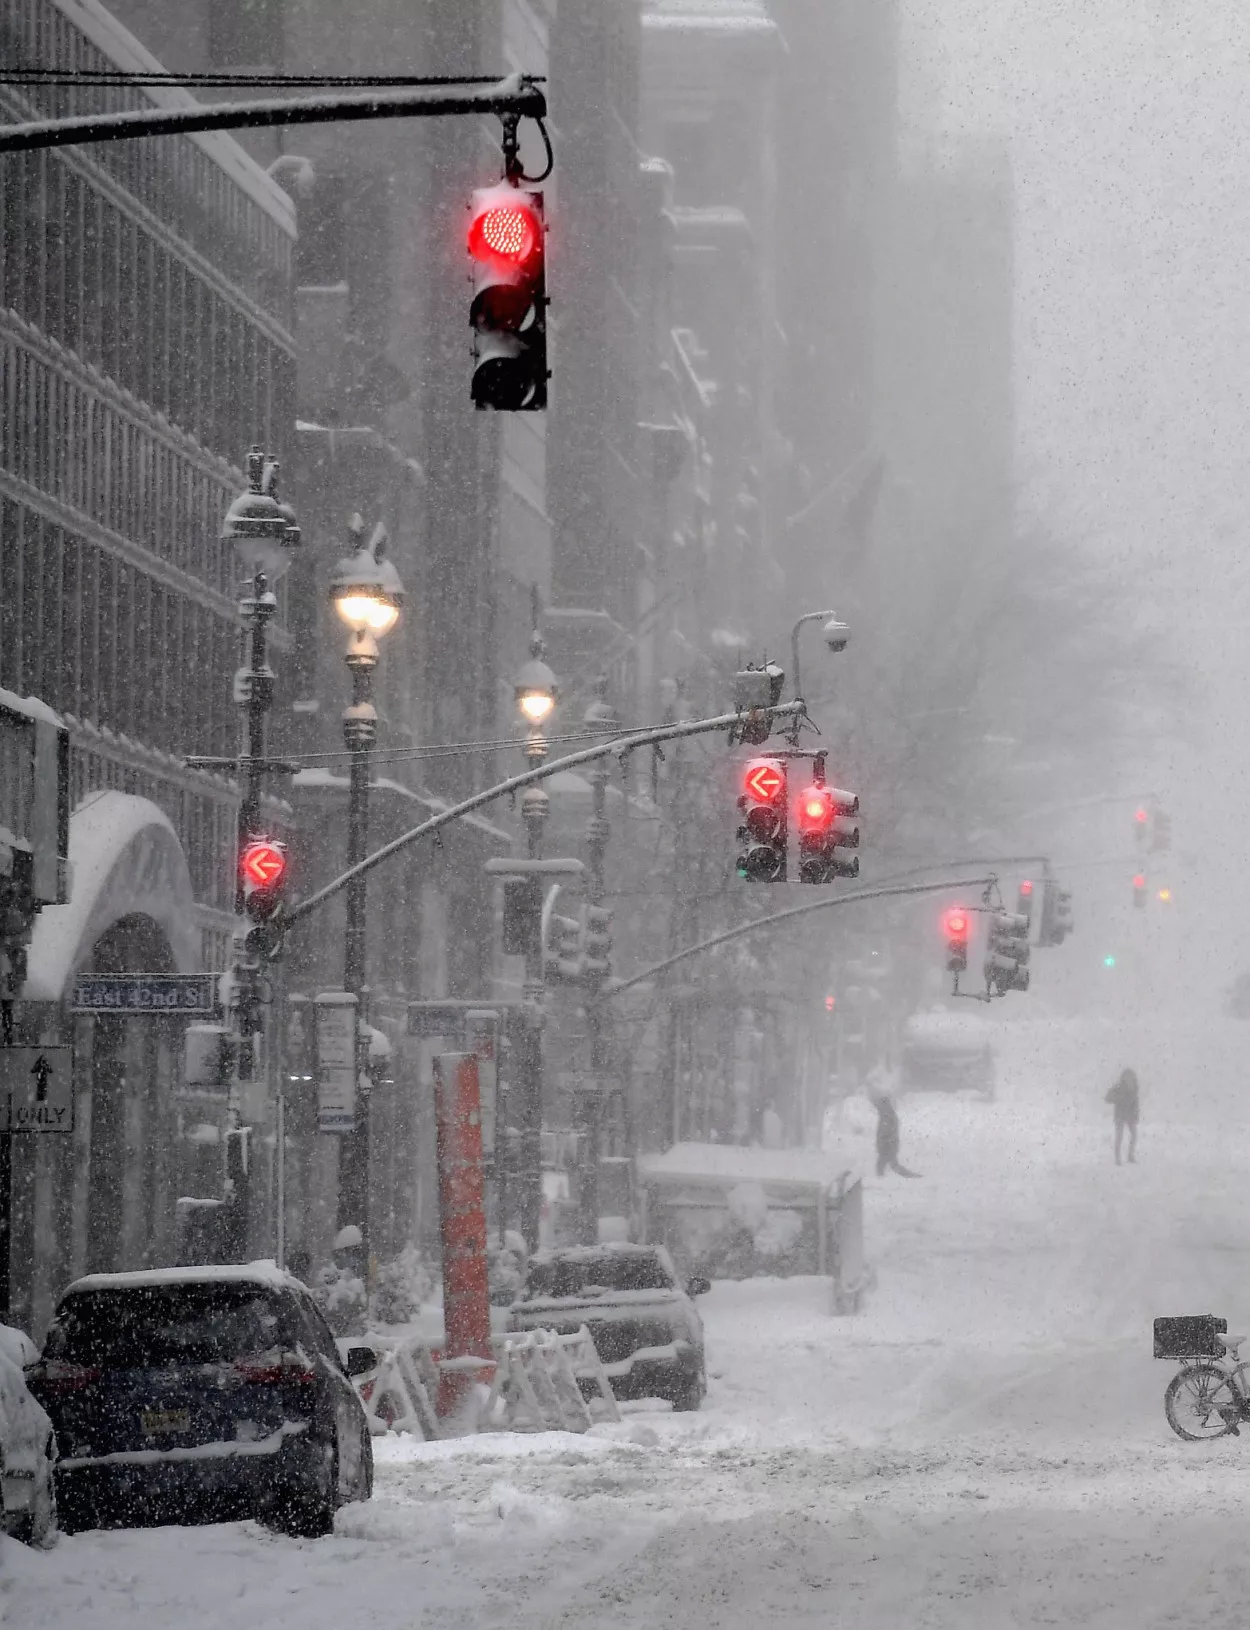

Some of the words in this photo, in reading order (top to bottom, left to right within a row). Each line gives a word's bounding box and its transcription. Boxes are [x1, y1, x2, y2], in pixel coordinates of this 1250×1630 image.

[77, 987, 122, 1006] East
[128, 988, 177, 1006] 42nd
[185, 987, 206, 1006] St
[17, 1107, 66, 1124] ONLY
